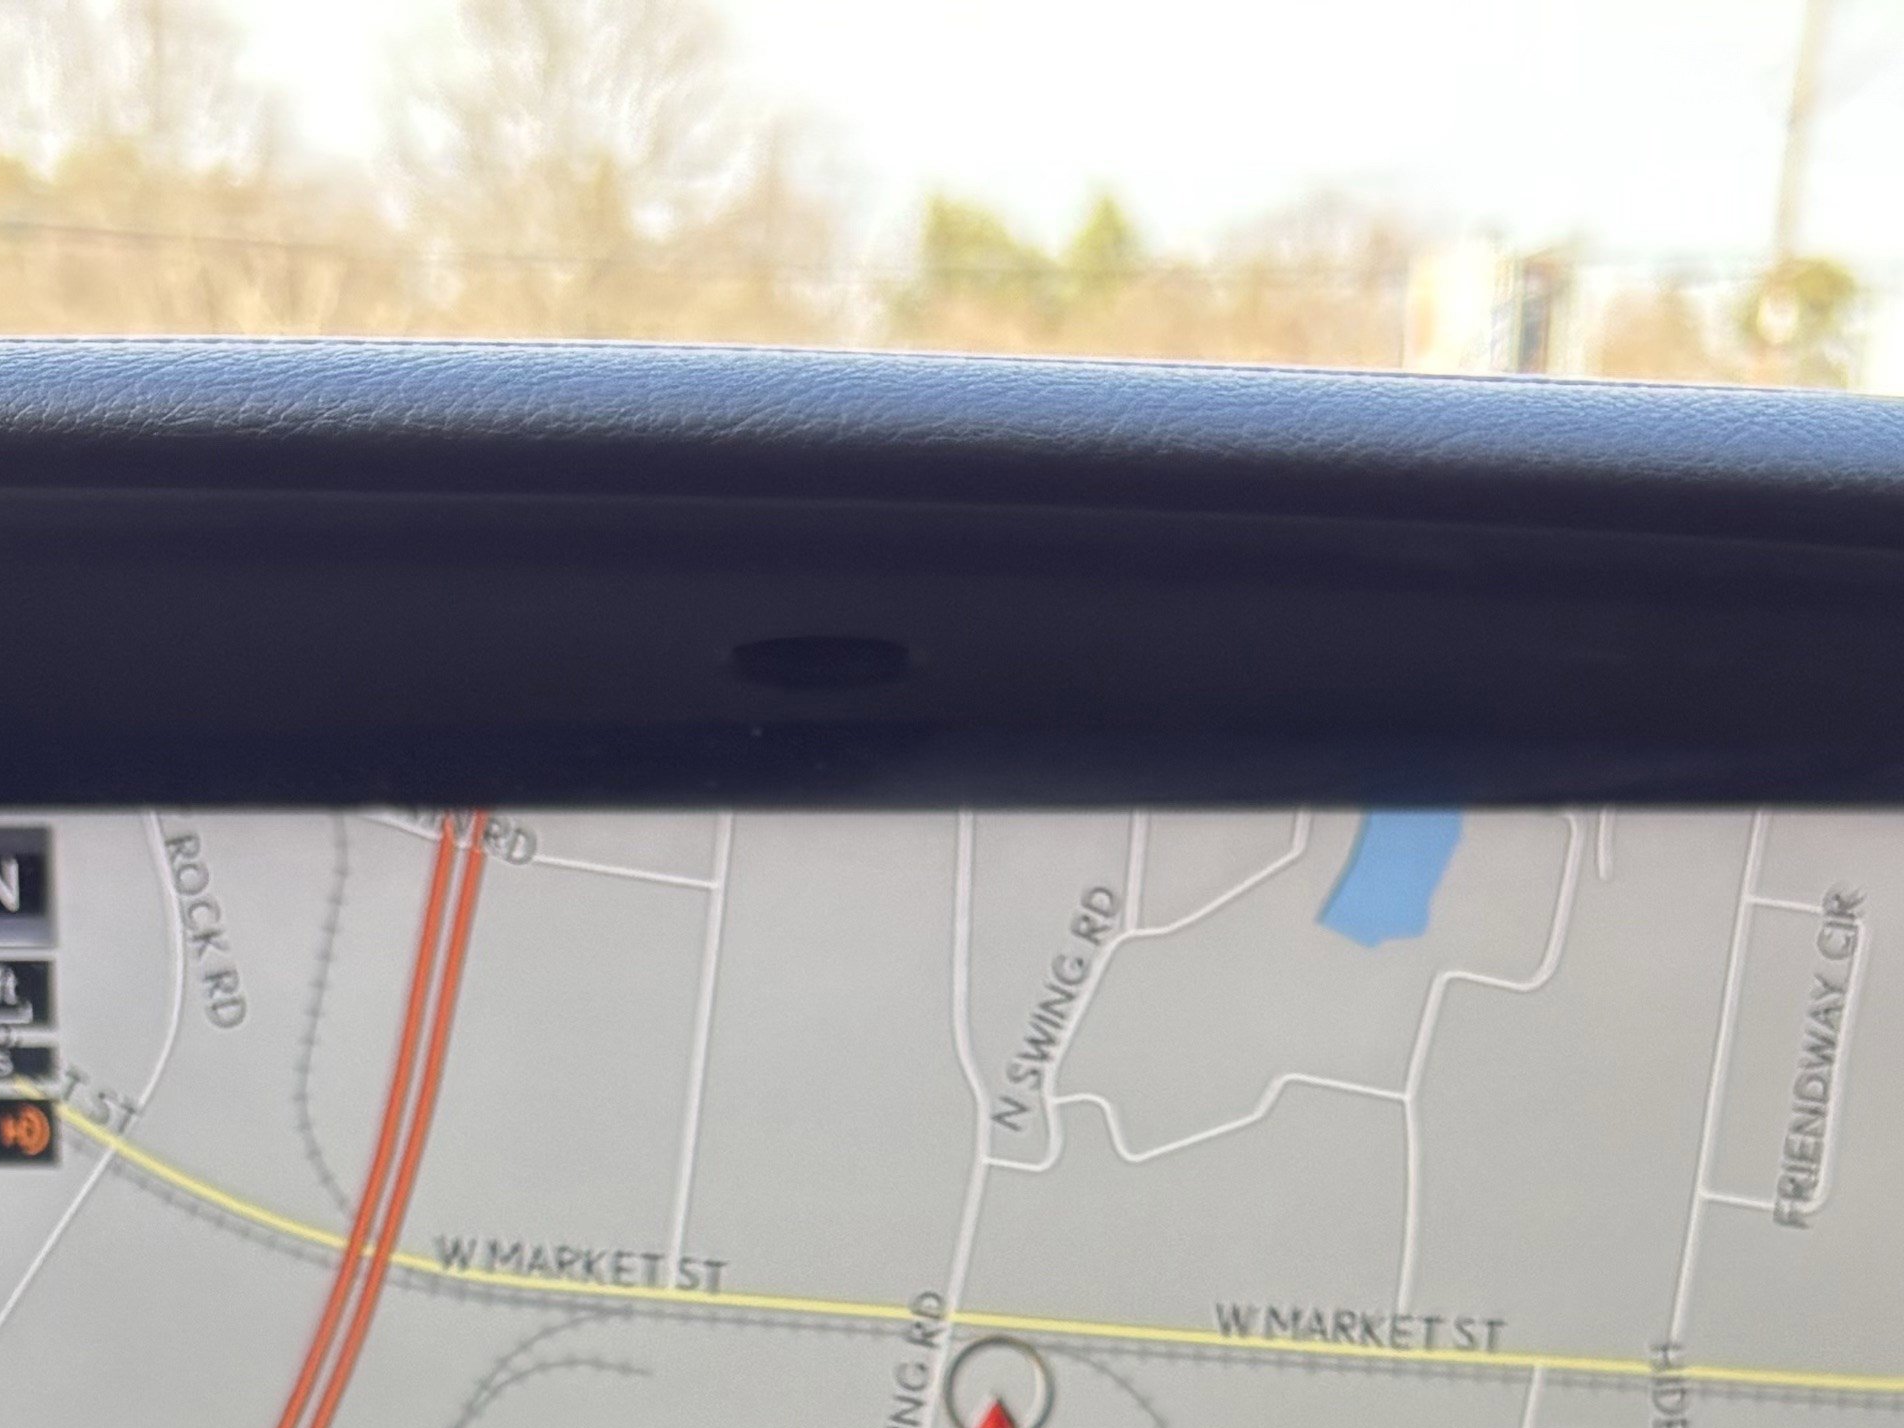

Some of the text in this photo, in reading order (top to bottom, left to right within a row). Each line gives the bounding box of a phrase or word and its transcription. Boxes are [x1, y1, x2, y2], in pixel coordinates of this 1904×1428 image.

[164, 833, 247, 1030] ROCK RD
[991, 886, 1119, 1132] N SWING RD
[1772, 883, 1866, 1230] FRIENDWAY CIR
[433, 1234, 729, 1294] W MARKET ST
[904, 1290, 946, 1349] RD
[1215, 1301, 1508, 1352] W MARKET ST
